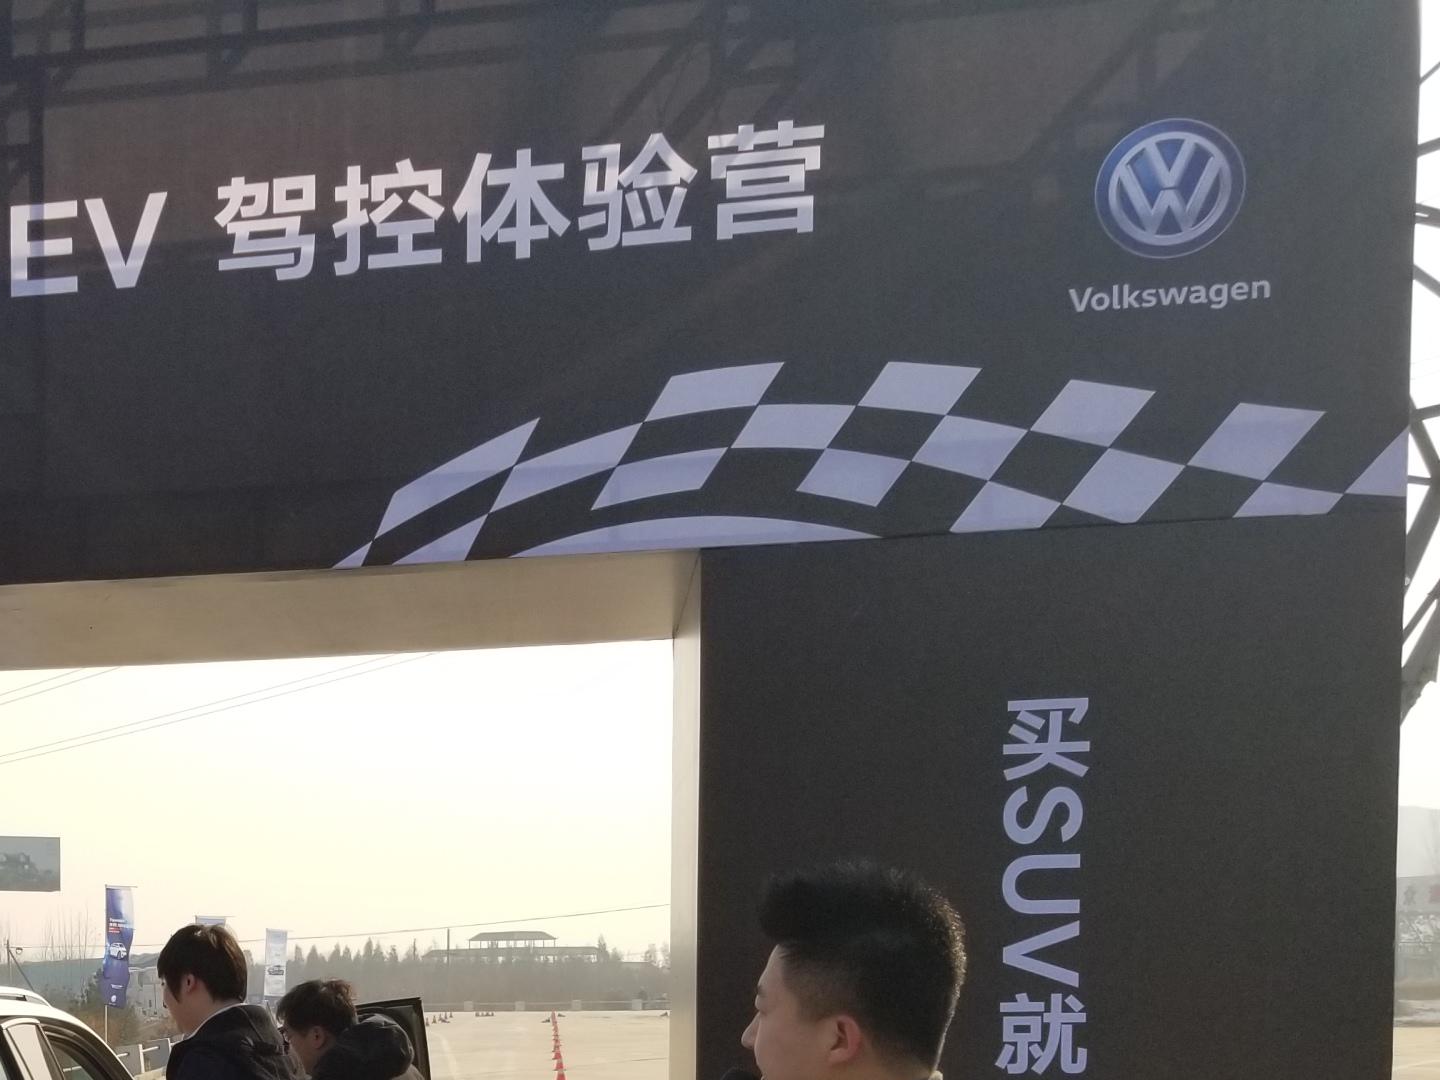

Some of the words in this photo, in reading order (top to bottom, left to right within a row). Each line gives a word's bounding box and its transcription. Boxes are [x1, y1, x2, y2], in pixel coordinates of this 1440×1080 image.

[213, 119, 826, 281] 驾控体验营
[1068, 279, 1272, 314] Volkswagen
